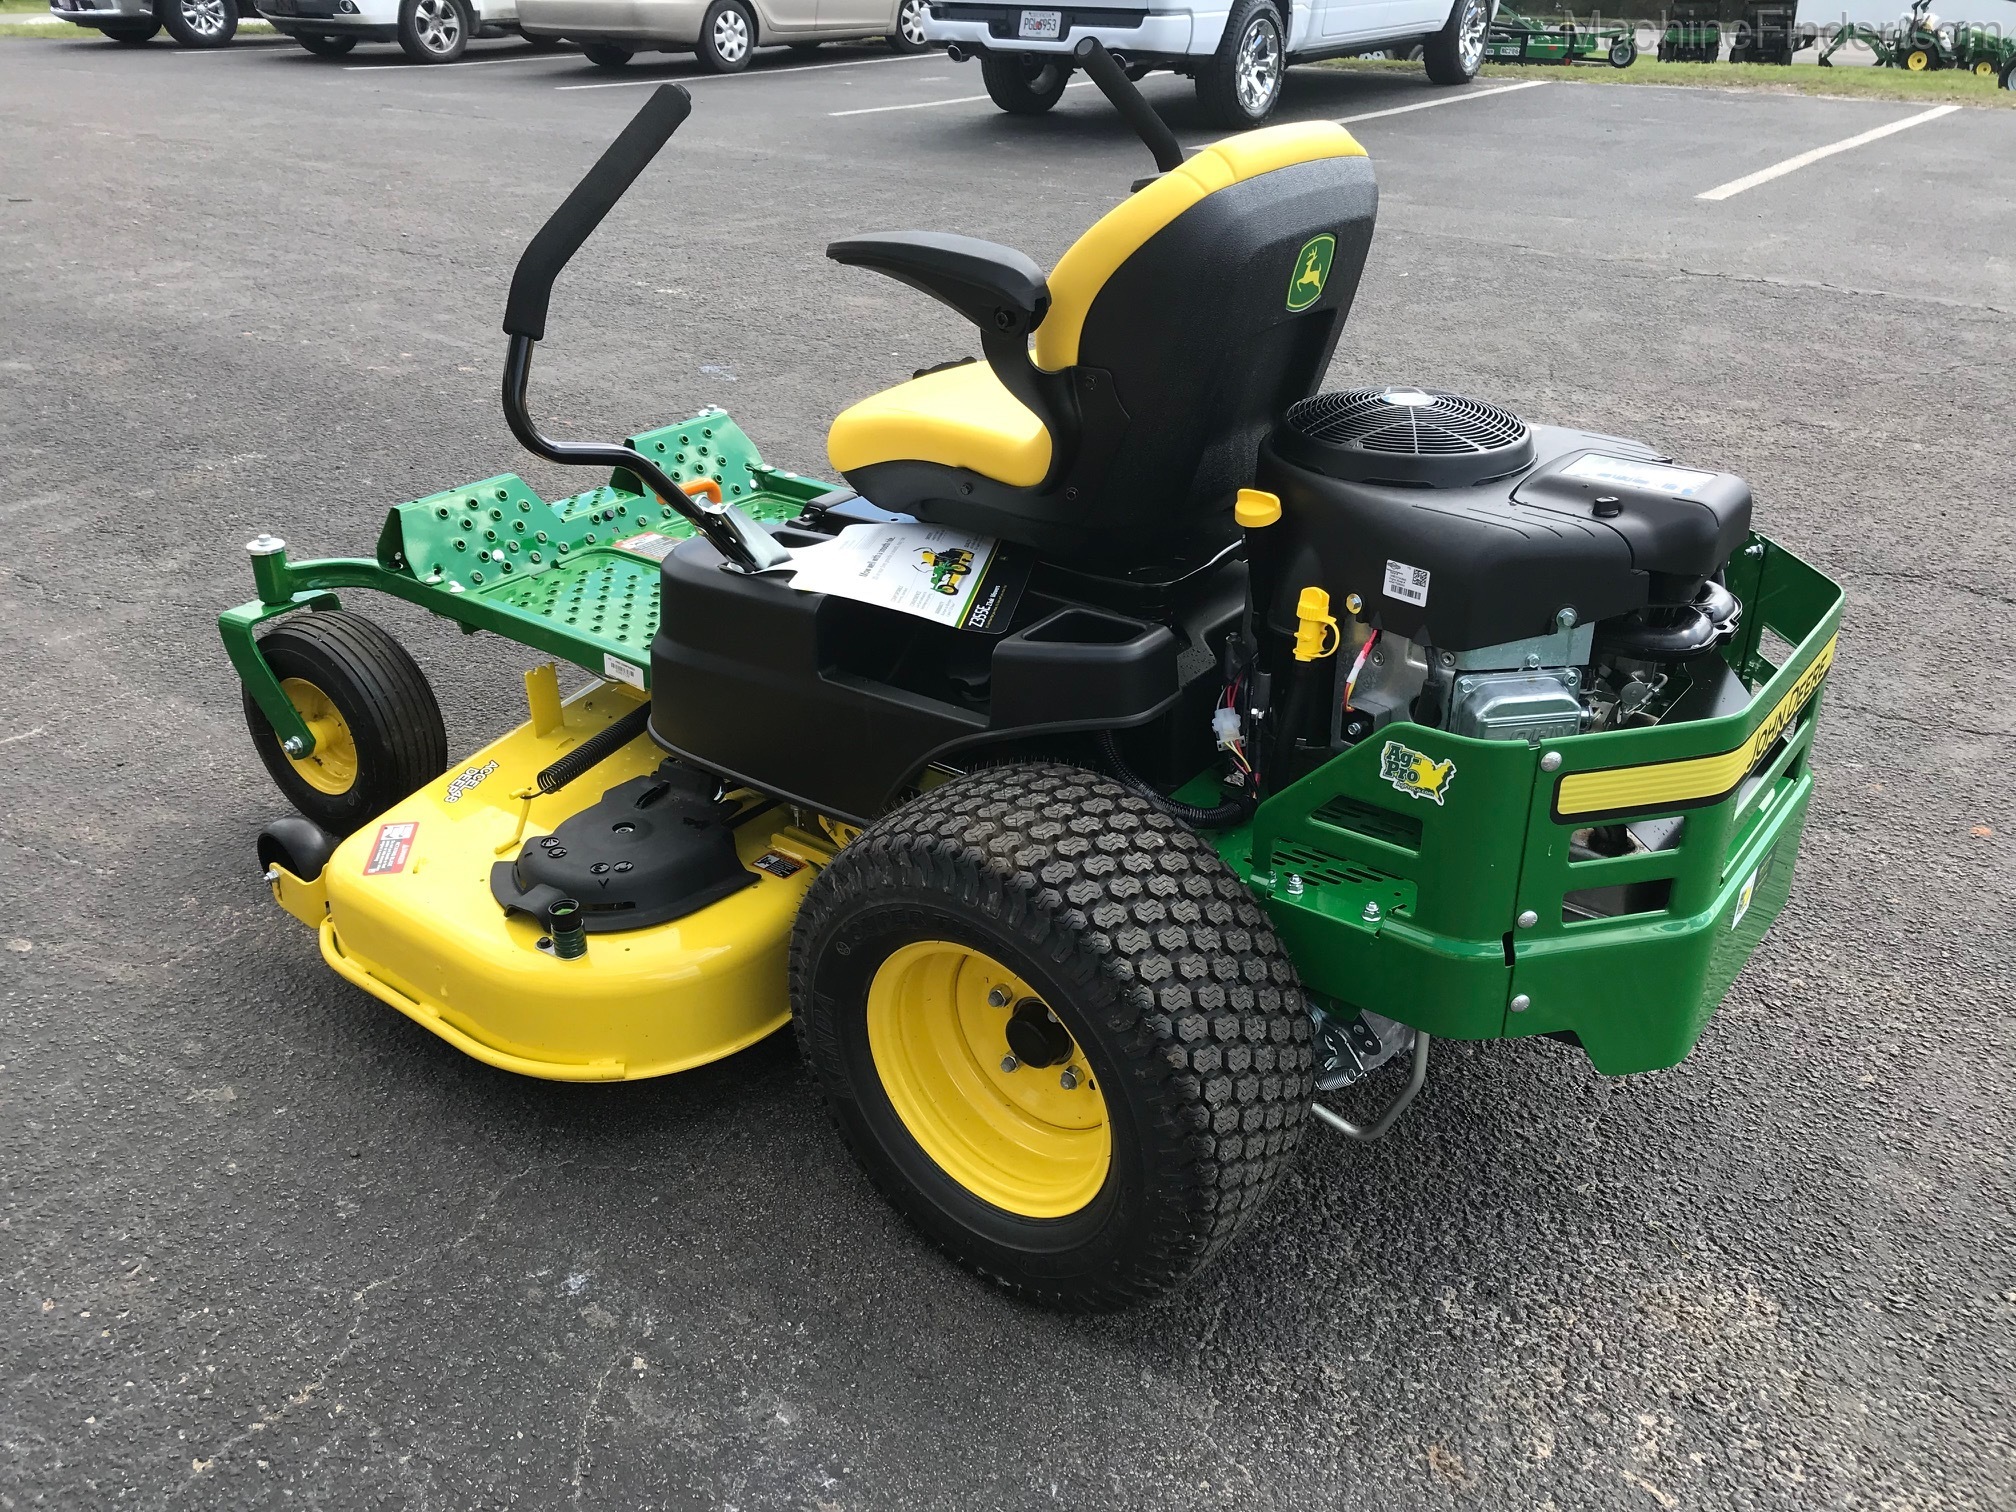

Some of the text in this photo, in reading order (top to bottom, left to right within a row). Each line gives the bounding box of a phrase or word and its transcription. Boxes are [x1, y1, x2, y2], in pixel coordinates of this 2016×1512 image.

[1746, 653, 1828, 771] JOHN DEERE
[1385, 743, 1422, 769] Ag-
[446, 766, 481, 796] DEEP
[460, 759, 500, 791] ACCEL
[1383, 760, 1420, 784] Pro
